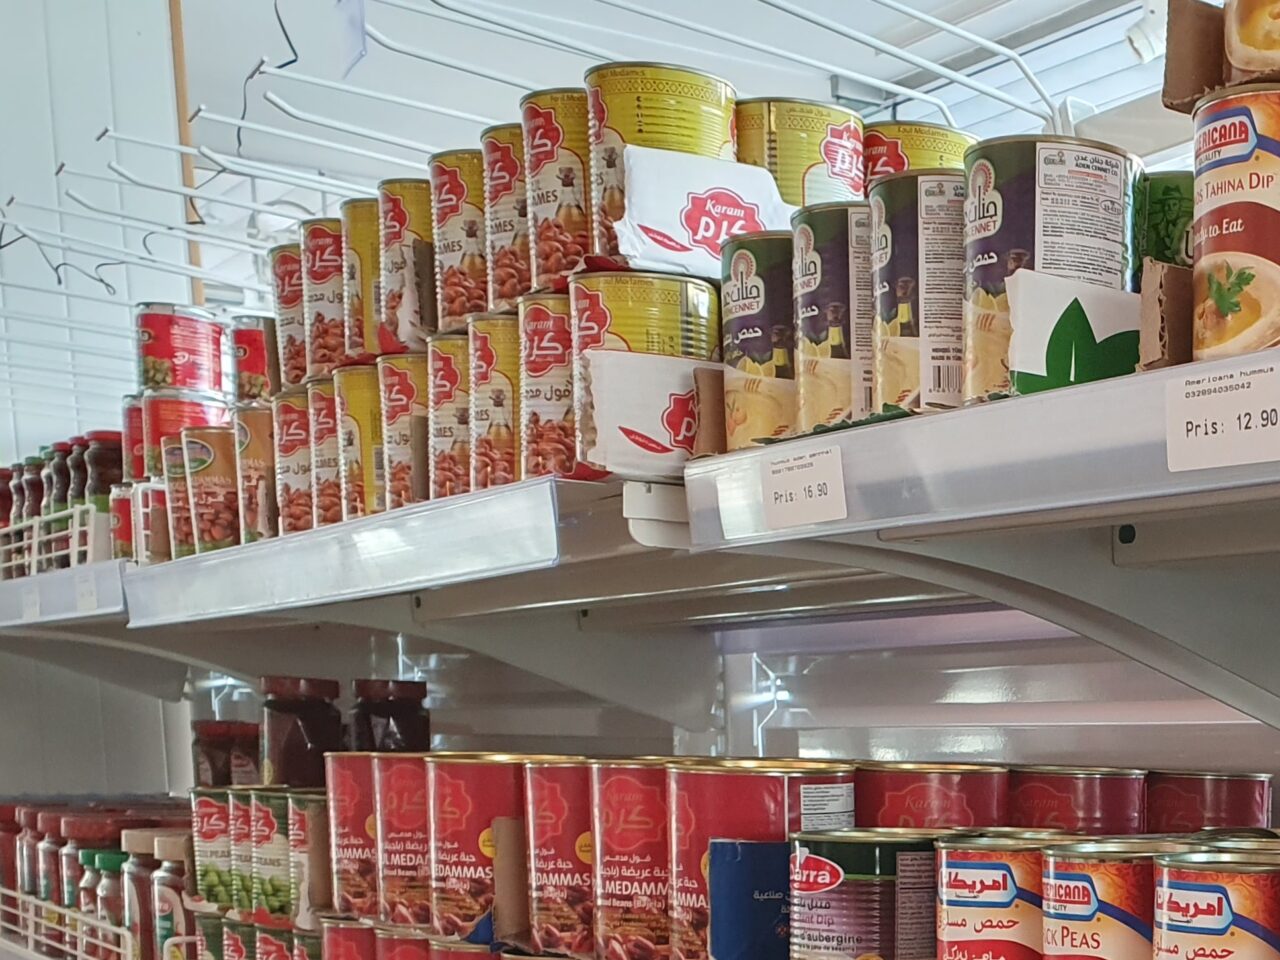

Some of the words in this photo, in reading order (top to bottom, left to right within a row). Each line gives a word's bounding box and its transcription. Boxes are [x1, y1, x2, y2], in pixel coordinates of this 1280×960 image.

[1205, 176, 1245, 200] TAHINA
[1249, 172, 1274, 190] DIP
[704, 198, 745, 218] Karam
[1222, 218, 1246, 235] Eat
[1184, 373, 1235, 387] Americana
[1185, 418, 1226, 438] Pris:
[1236, 408, 1279, 431] 12.90
[773, 491, 798, 504] Pris:
[803, 482, 829, 499] 16.90
[973, 916, 1020, 934] حمص
[1061, 926, 1101, 949] PEAS
